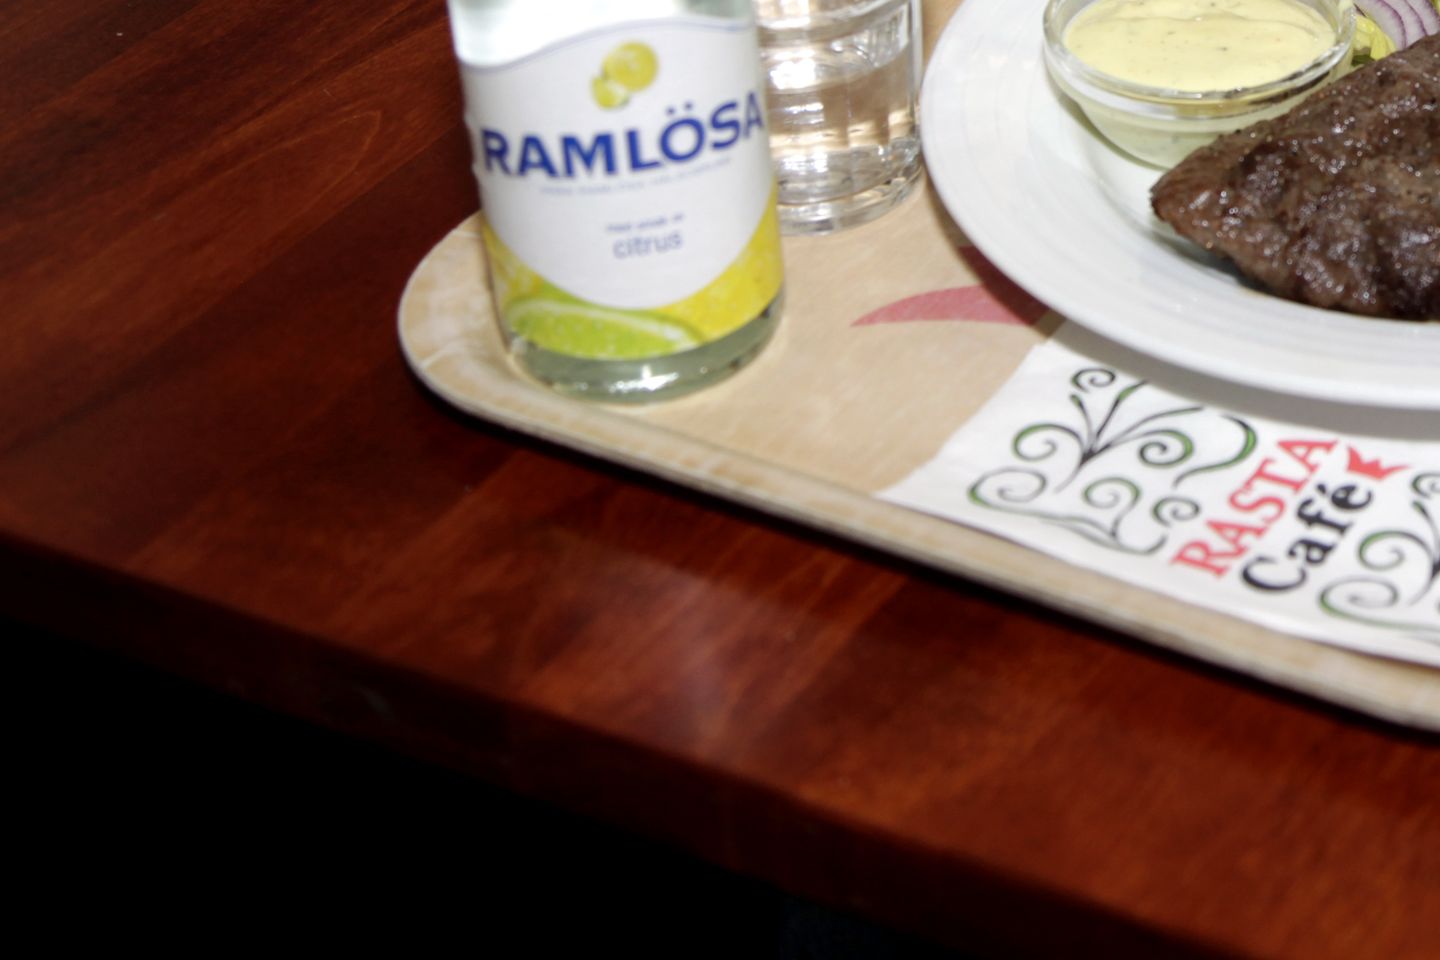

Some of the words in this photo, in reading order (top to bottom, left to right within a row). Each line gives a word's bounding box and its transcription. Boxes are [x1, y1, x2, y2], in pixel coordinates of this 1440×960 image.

[480, 92, 764, 179] RAMLÖSA
[612, 231, 684, 259] citrus
[1170, 439, 1340, 577] RASTA
[1240, 483, 1373, 593] Café
